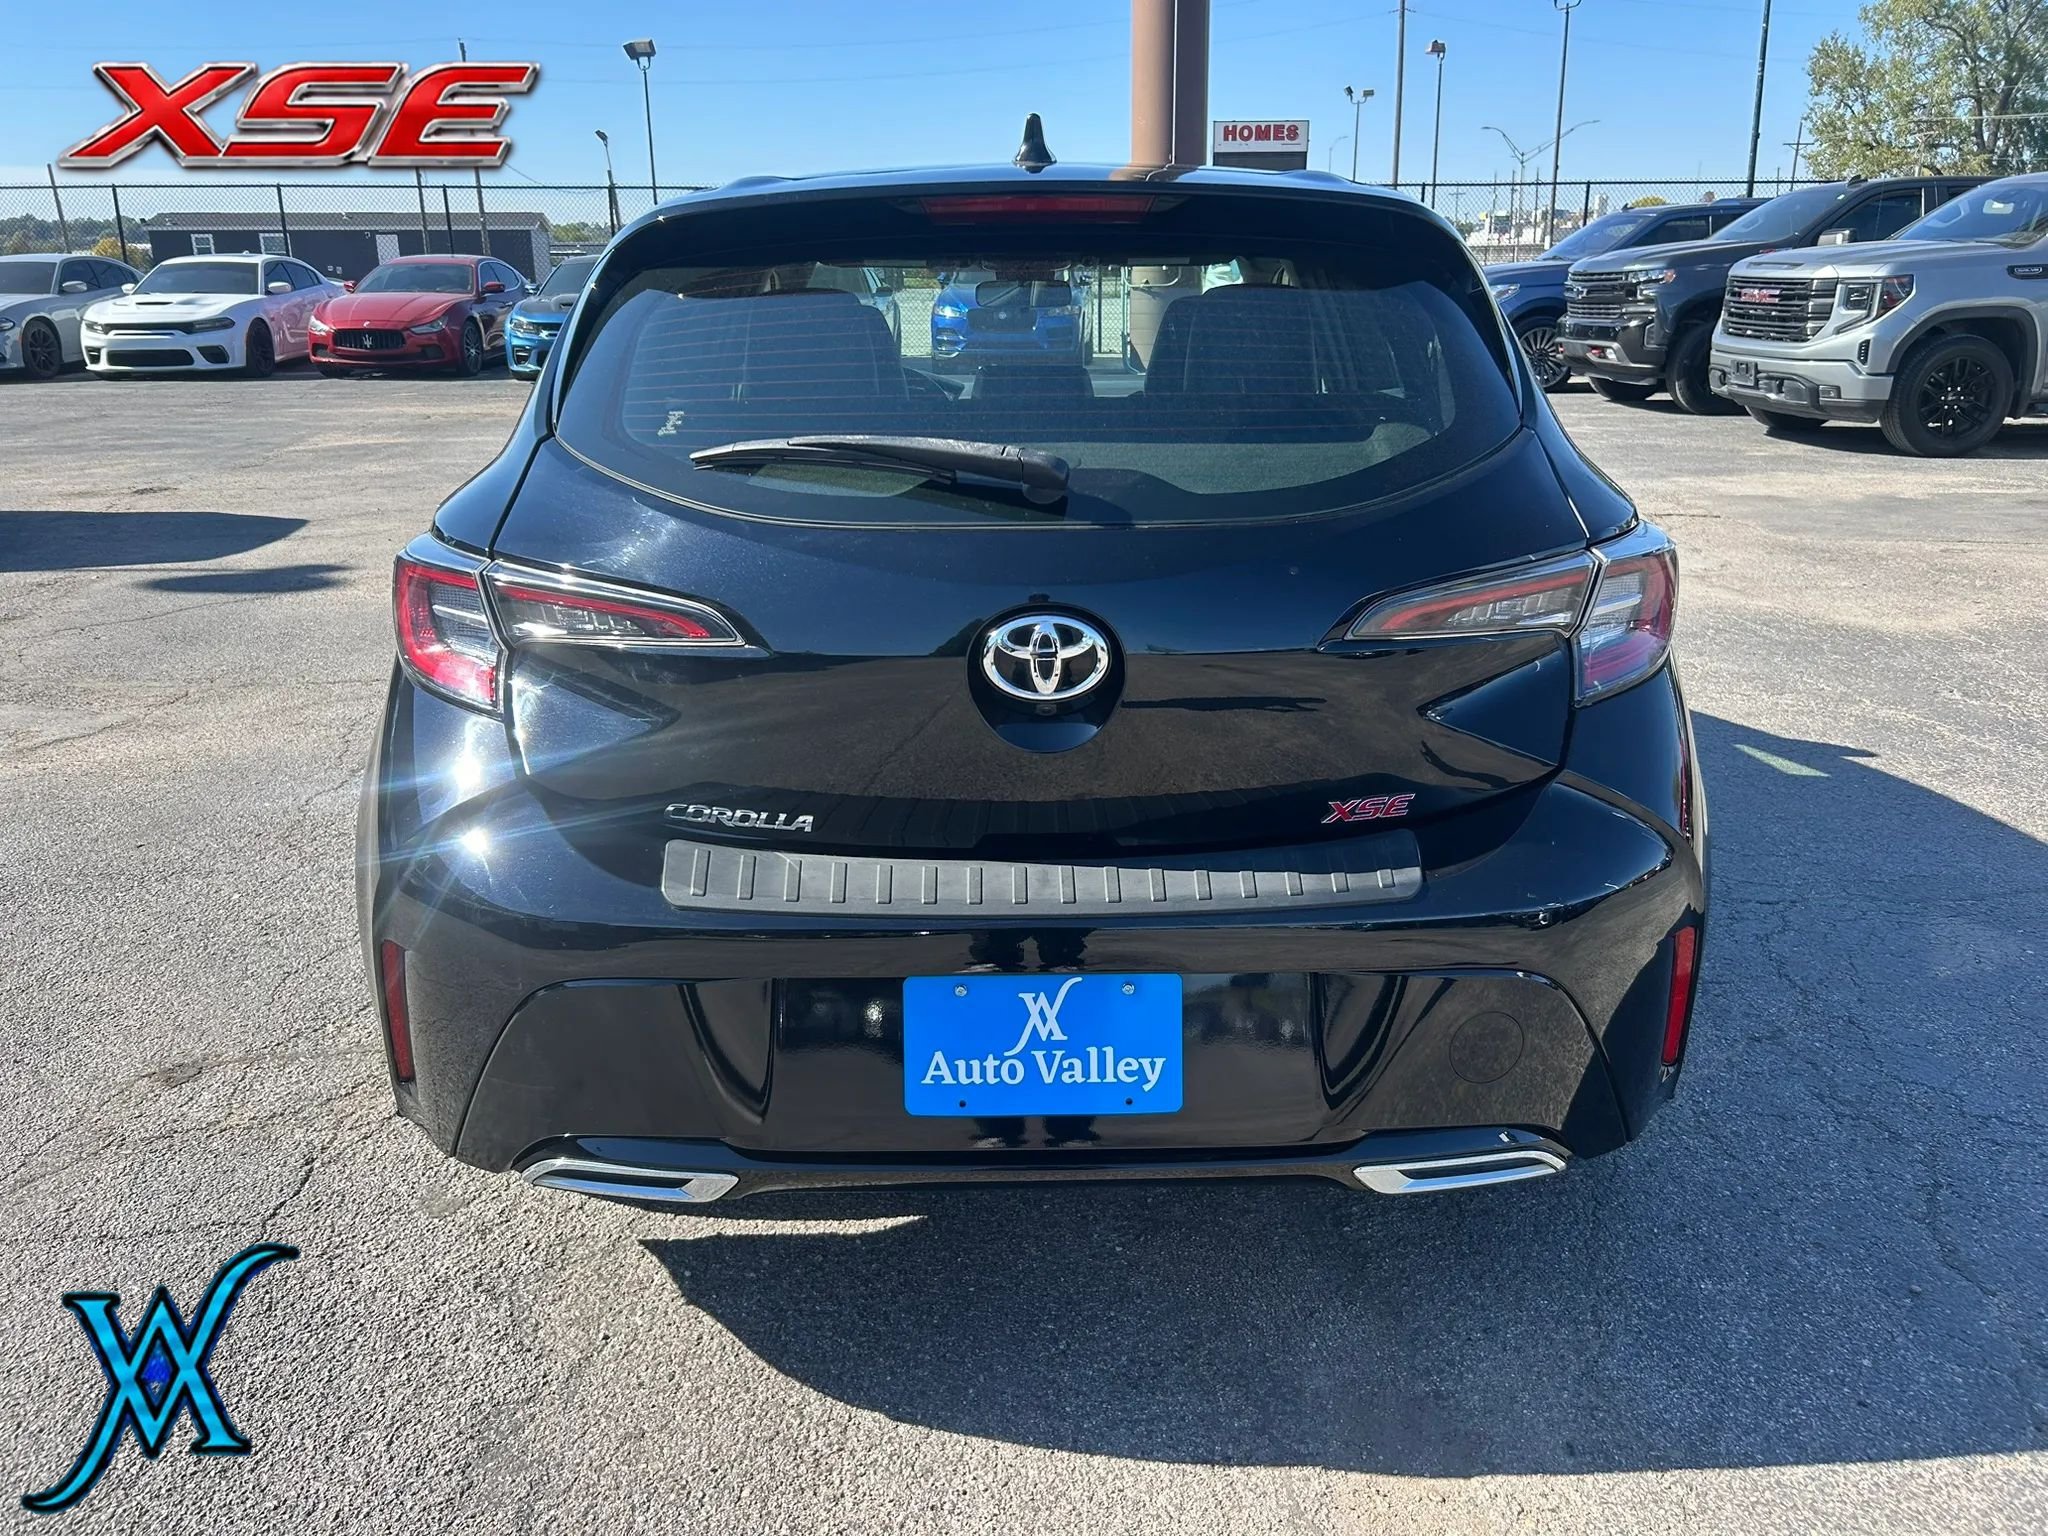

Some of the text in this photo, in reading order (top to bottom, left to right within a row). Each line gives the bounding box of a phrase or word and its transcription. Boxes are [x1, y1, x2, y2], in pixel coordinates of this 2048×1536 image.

[1223, 124, 1299, 142] HOMES
[664, 803, 815, 832] COROLLA
[1321, 793, 1416, 823] XSE
[921, 1046, 1166, 1092] Auto Valley
